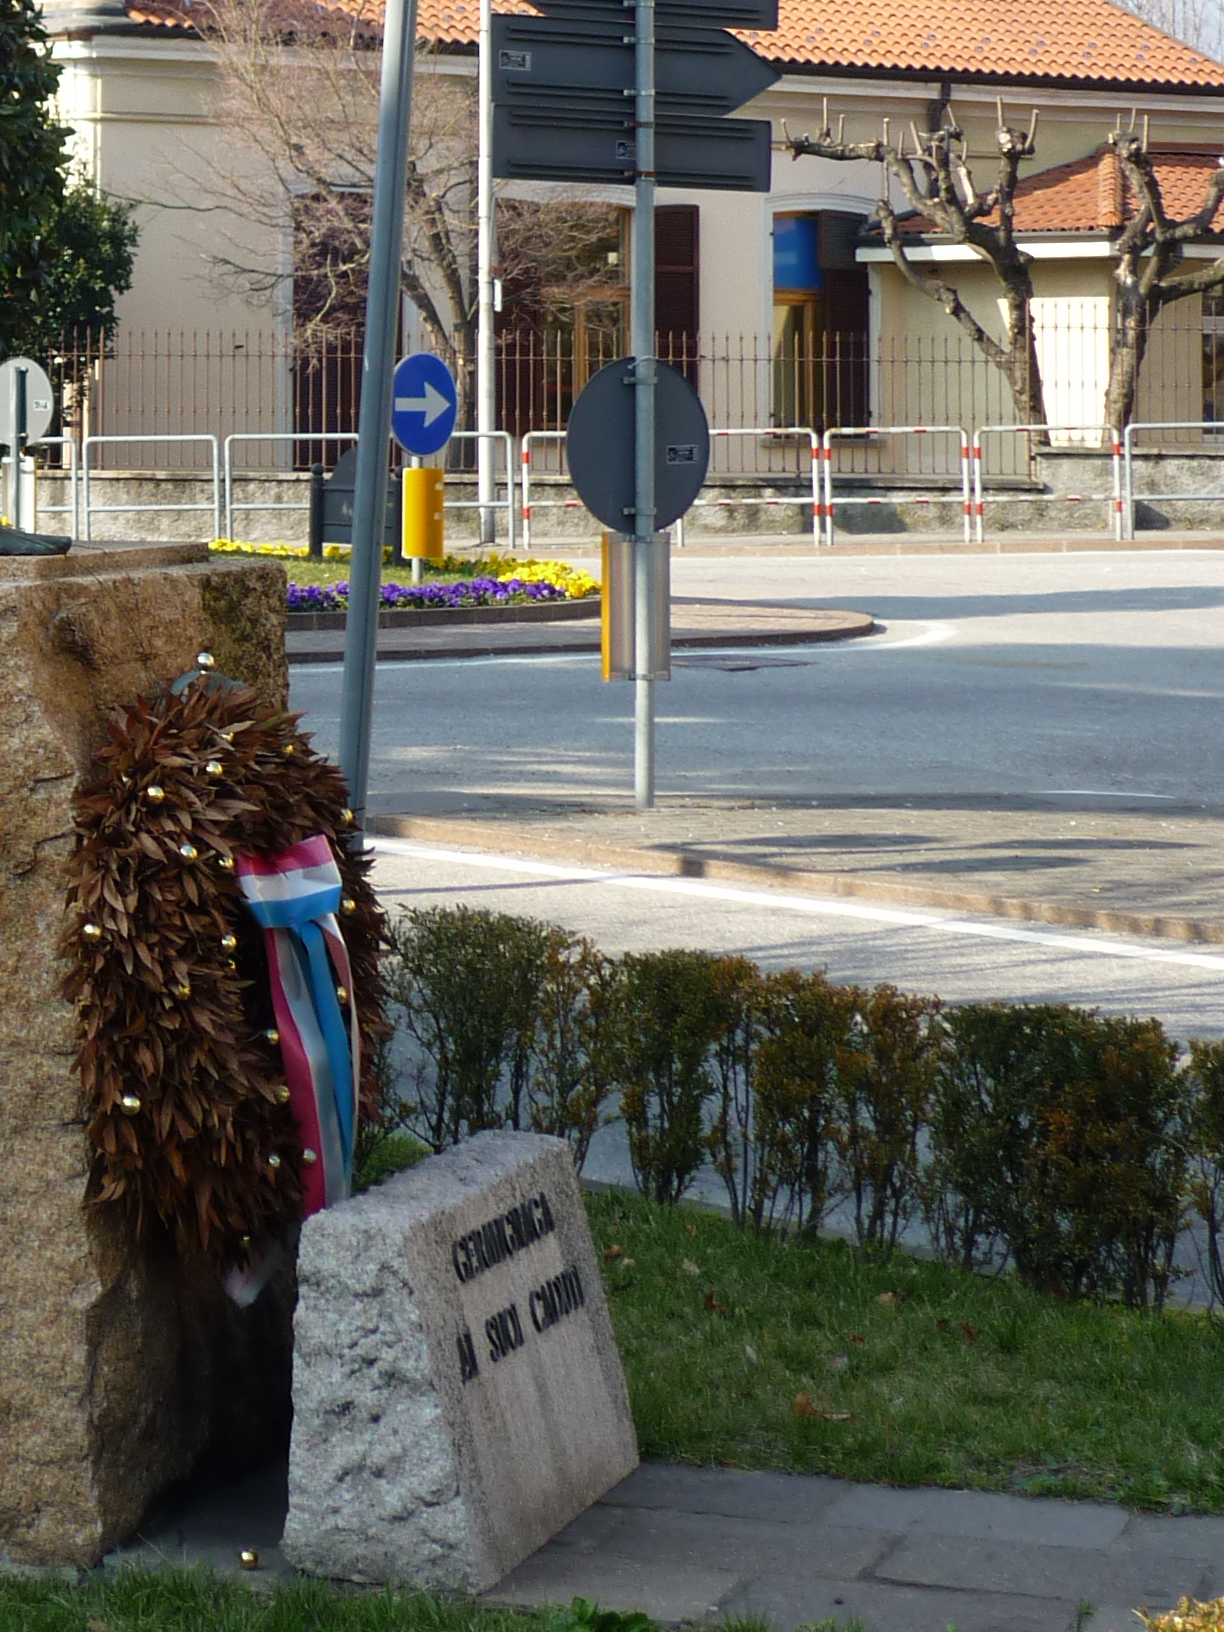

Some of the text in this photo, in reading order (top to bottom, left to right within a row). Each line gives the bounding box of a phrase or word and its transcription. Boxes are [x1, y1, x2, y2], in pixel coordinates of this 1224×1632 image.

[456, 1264, 585, 1385] AI SUOI CADUTI
